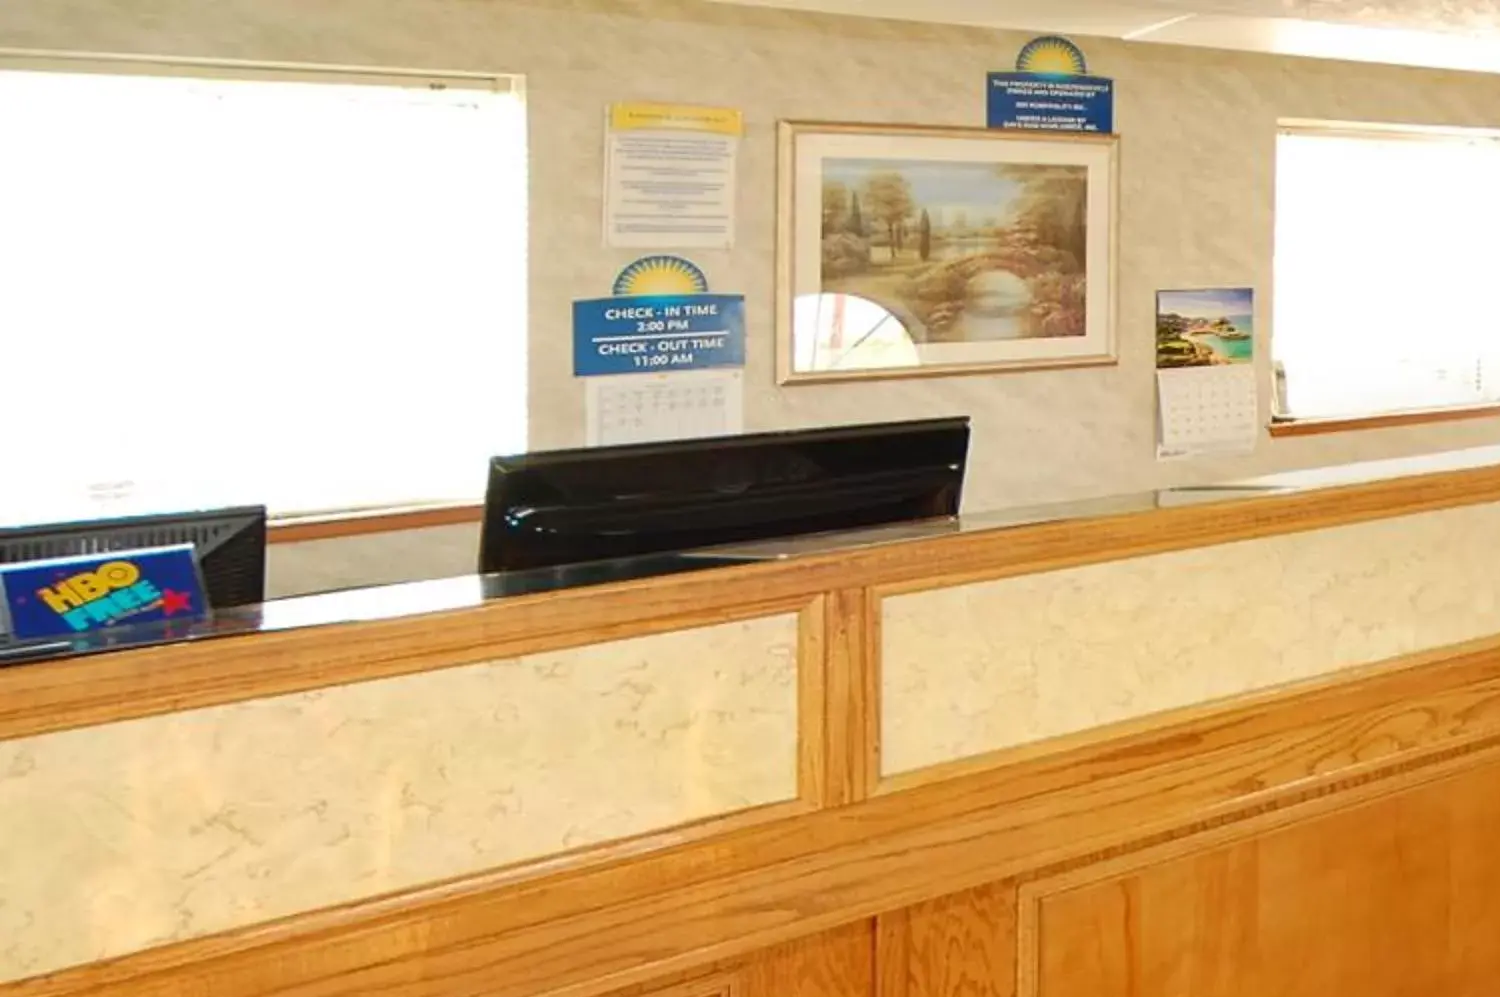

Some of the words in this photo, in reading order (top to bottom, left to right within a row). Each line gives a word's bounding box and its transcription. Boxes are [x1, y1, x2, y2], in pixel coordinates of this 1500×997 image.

[605, 306, 653, 320] CHECK
[665, 305, 680, 318] IN
[685, 304, 718, 316] TIME
[637, 320, 665, 333] 2:00
[668, 319, 689, 331] PM
[598, 342, 646, 355] CHECK
[658, 340, 687, 352] OUT
[692, 338, 725, 349] TIME
[633, 355, 668, 367] 11:00
[671, 353, 693, 365] AM
[36, 560, 141, 615] HBO
